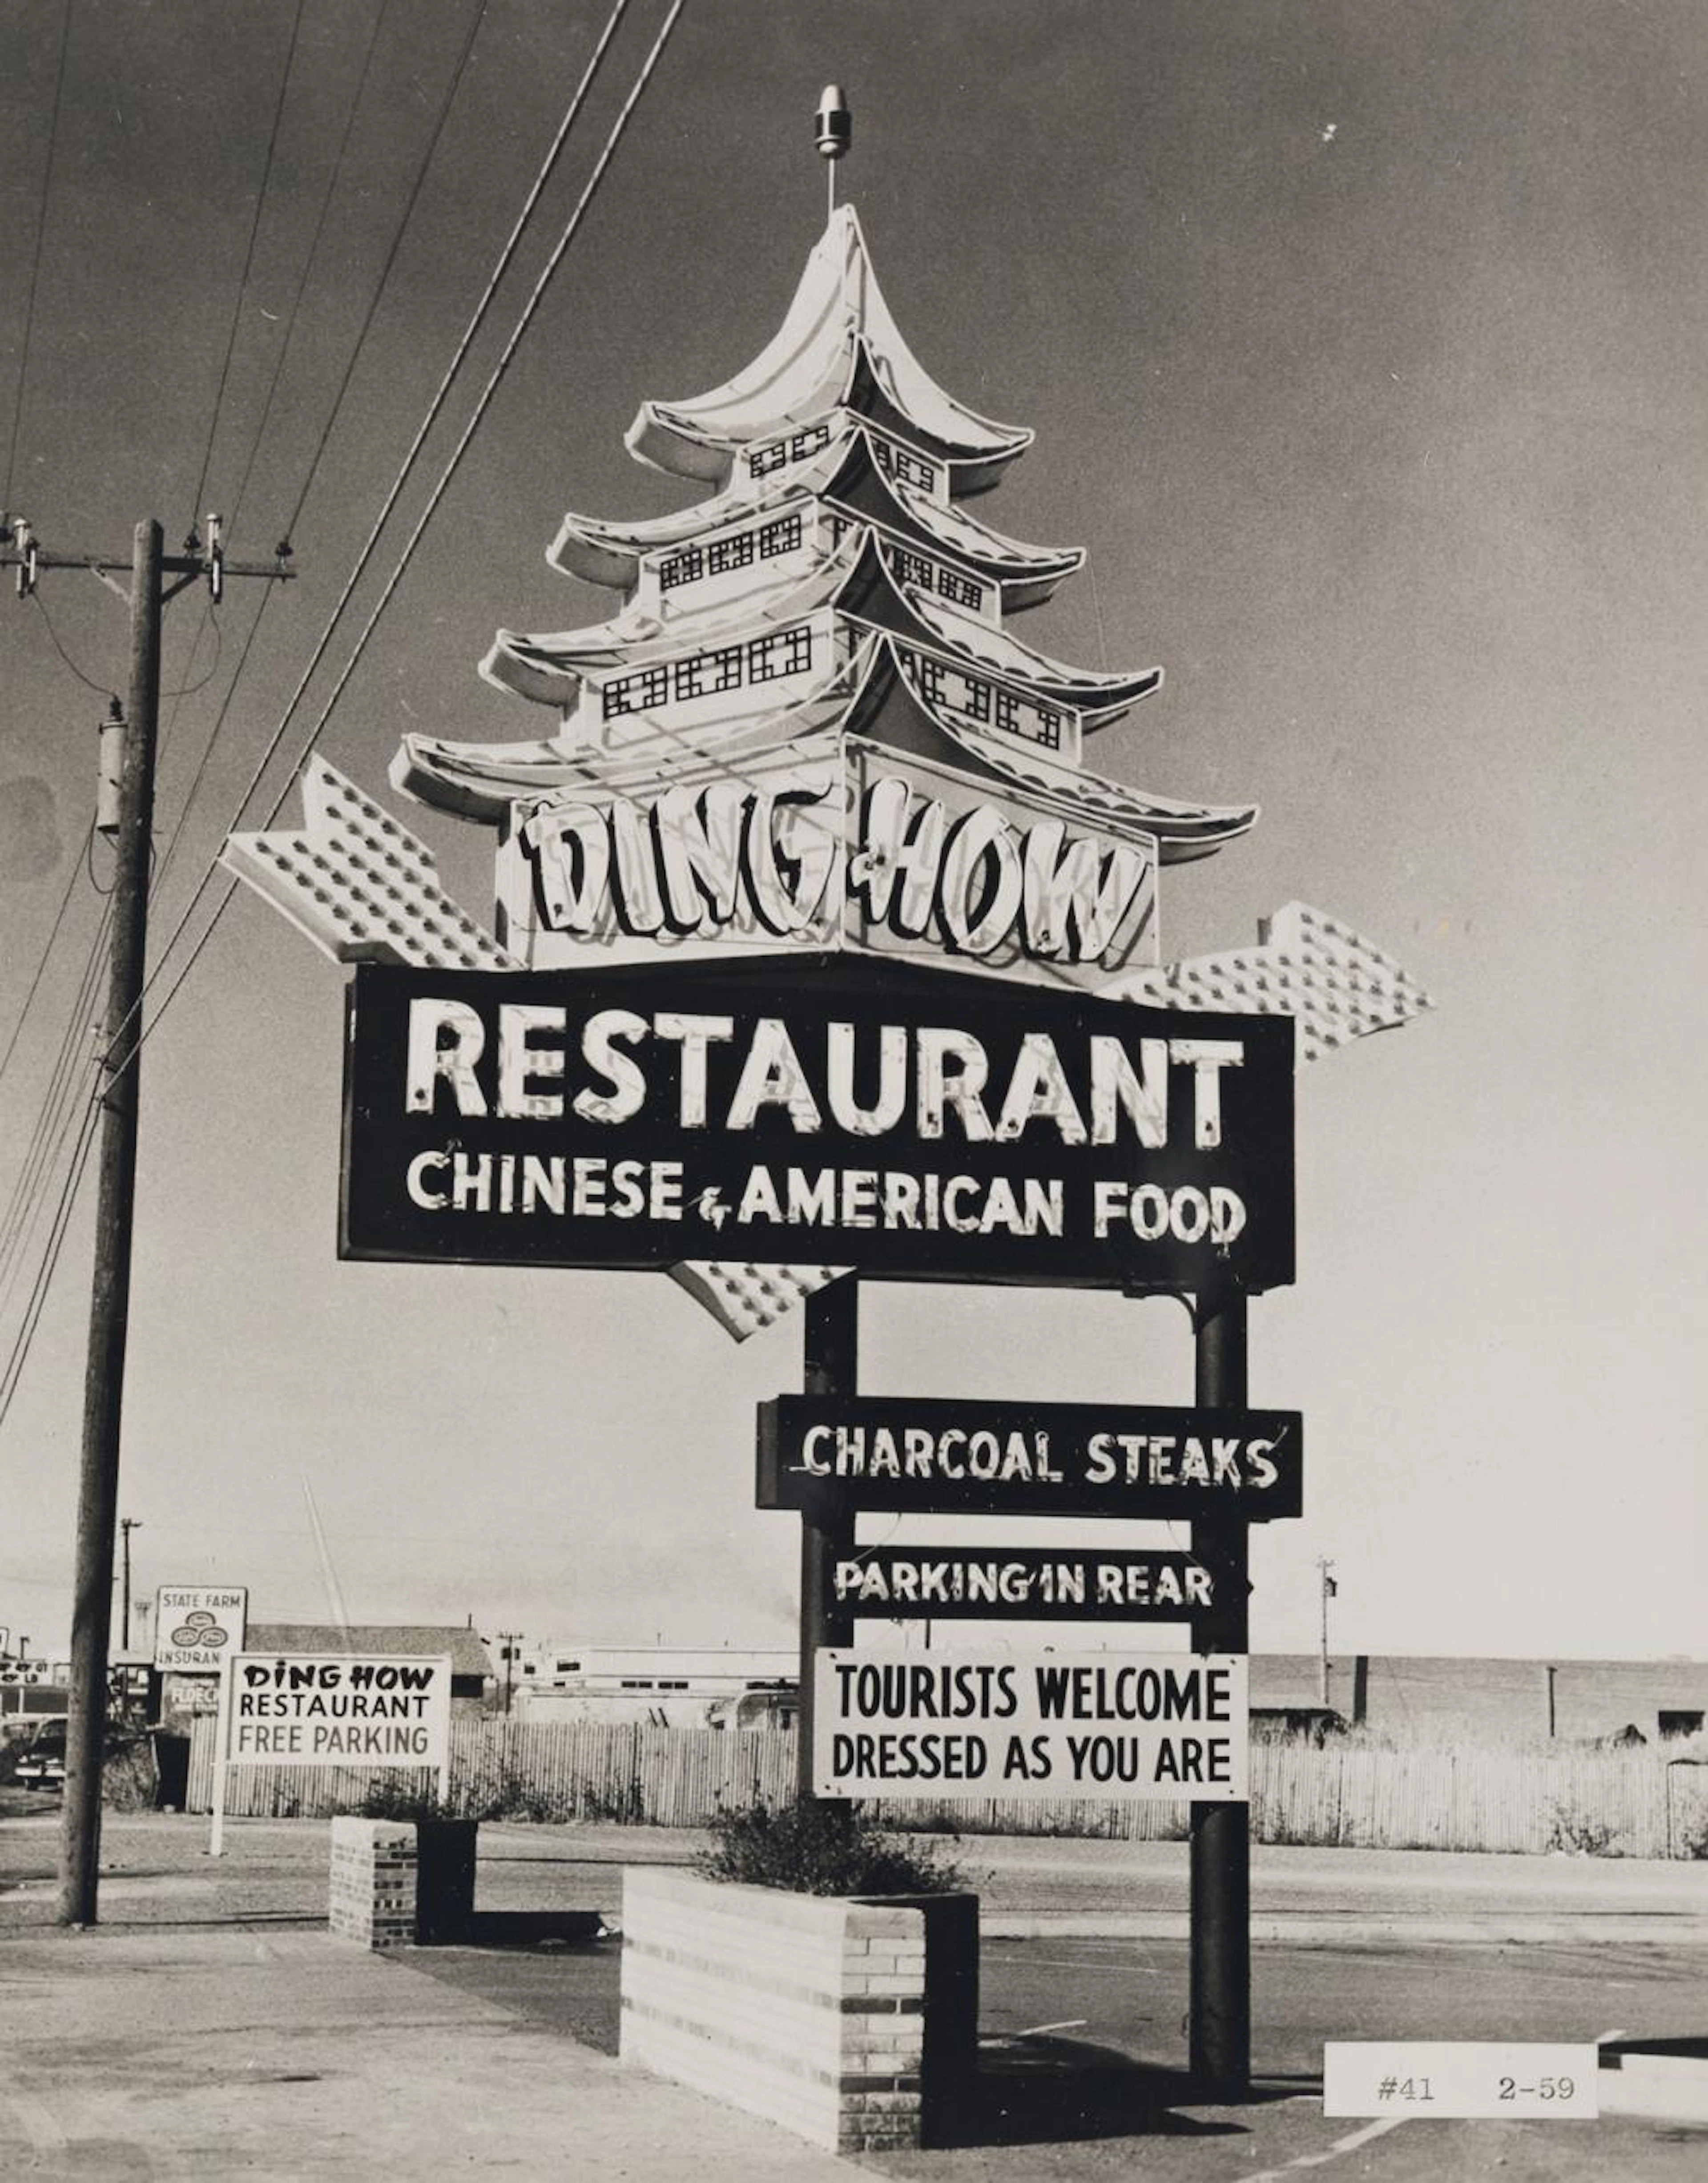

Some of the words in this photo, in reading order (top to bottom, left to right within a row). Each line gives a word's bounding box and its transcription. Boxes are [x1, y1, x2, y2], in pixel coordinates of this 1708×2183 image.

[523, 776, 838, 938] DING
[850, 777, 1150, 963] HOW
[406, 998, 1244, 1149] RESTAURANT
[407, 1150, 683, 1220] CHINESE
[698, 1185, 732, 1231] &
[737, 1164, 1064, 1237] AMERICAN
[1093, 1181, 1246, 1244] FOOD
[802, 1426, 1063, 1482] CHARCOAL
[1085, 1433, 1280, 1489] STEAKS
[164, 1594, 200, 1607] STATE
[206, 1595, 241, 1608] FARM
[835, 1561, 1031, 1602] PARKING
[1040, 1563, 1085, 1603] IN
[1097, 1564, 1213, 1607] REAR
[158, 1650, 220, 1664] INSURAN
[350, 1665, 435, 1691] HOW
[240, 1694, 430, 1718] RESTAURANT
[835, 1663, 1018, 1719] TOURISTS
[1036, 1666, 1231, 1721] WELCOME
[238, 1724, 302, 1753] FREE
[314, 1726, 428, 1755] PARKING
[832, 1733, 988, 1779] DRESSED
[1003, 1735, 1052, 1780] AS
[1067, 1736, 1139, 1781] YOU
[1154, 1737, 1231, 1782] ARE
